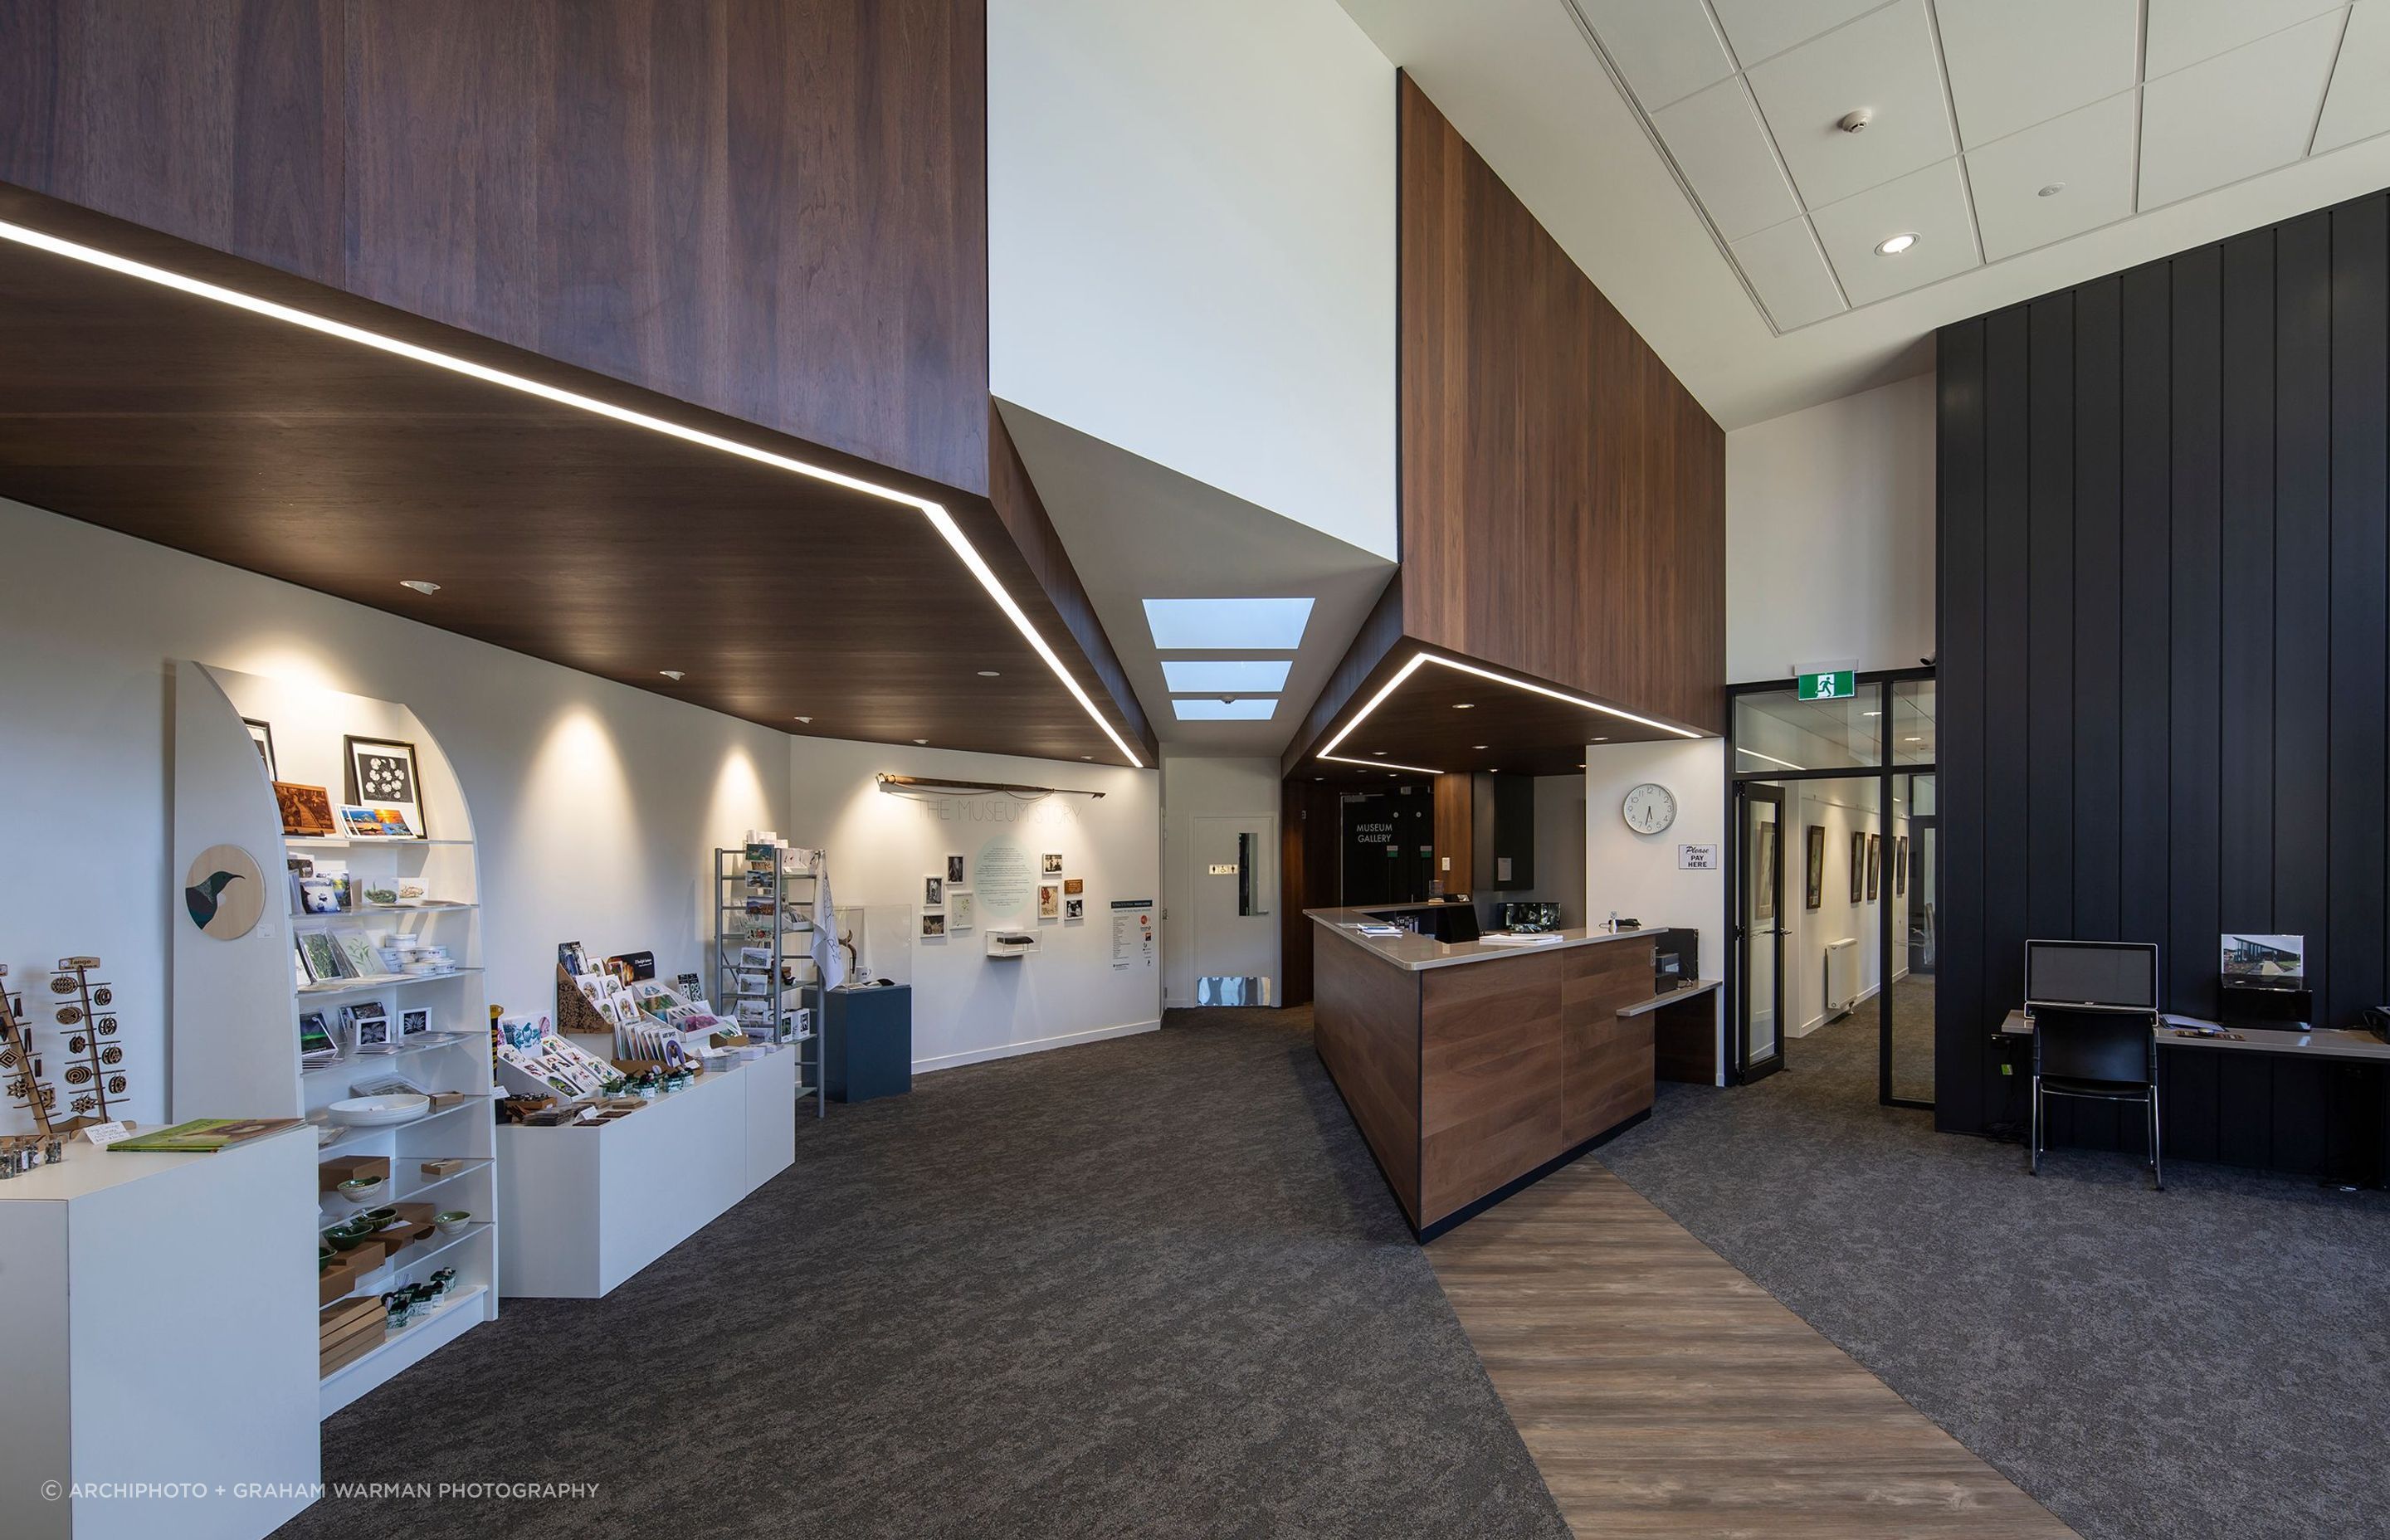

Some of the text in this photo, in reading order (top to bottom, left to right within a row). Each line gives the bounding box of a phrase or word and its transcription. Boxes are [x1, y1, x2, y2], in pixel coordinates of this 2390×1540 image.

[917, 798, 1083, 824] THE MUSEUM STORY
[1356, 823, 1393, 832] MUSEUM
[1358, 834, 1392, 843] GALLERY
[1686, 846, 1710, 854] Please
[69, 958, 92, 966] Tango
